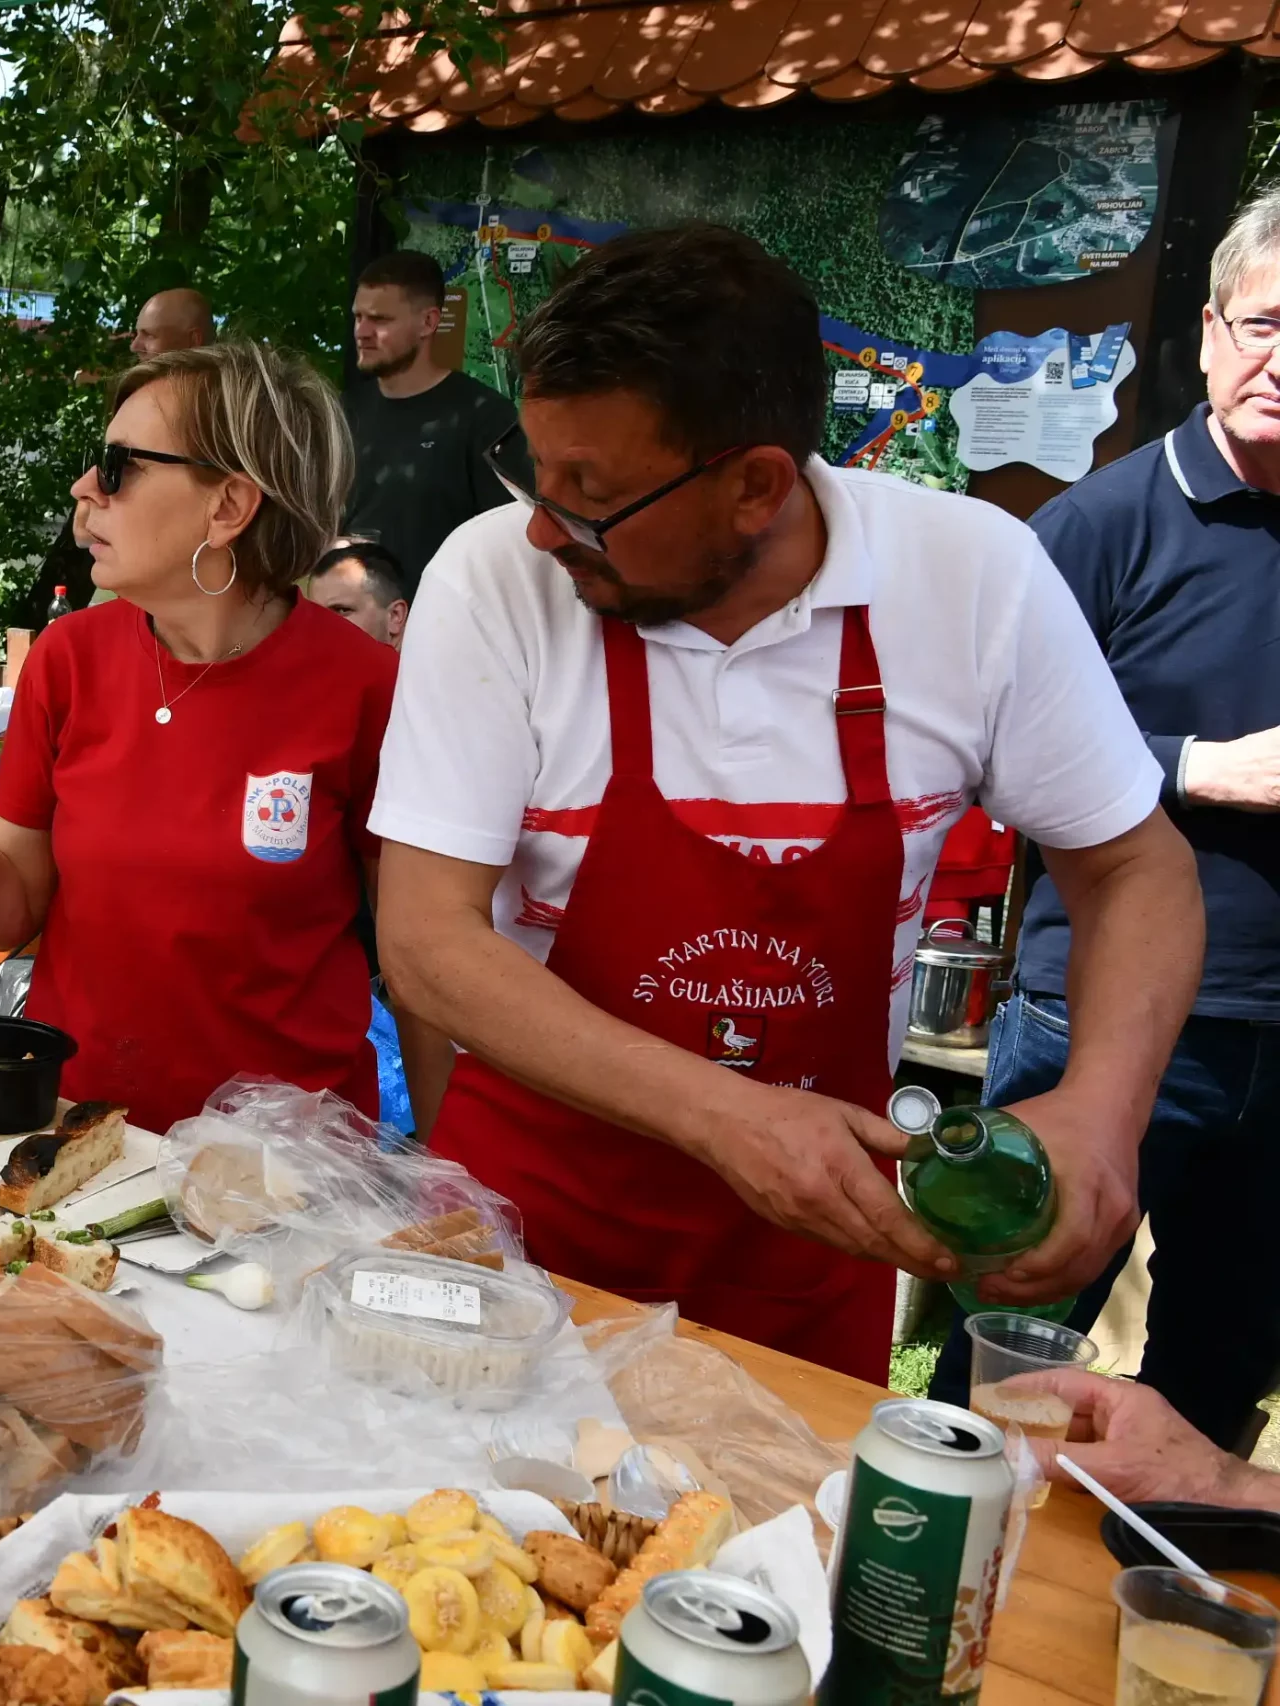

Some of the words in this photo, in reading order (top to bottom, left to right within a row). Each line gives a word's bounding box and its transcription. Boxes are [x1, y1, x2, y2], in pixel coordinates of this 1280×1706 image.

[1096, 200, 1143, 210] VRHOVLJAN
[863, 350, 872, 362] 6
[981, 354, 1027, 365] aplikacija
[910, 366, 918, 377] 7
[926, 396, 934, 408] 8
[896, 413, 904, 425] 9
[247, 787, 264, 804] NK
[271, 798, 292, 822] P
[252, 825, 284, 846] Martin
[286, 834, 298, 845] na
[658, 928, 758, 972] MARTIN
[766, 936, 802, 966] NA
[800, 956, 835, 1009] MURI
[669, 977, 806, 1009] GULAŠIJADA
